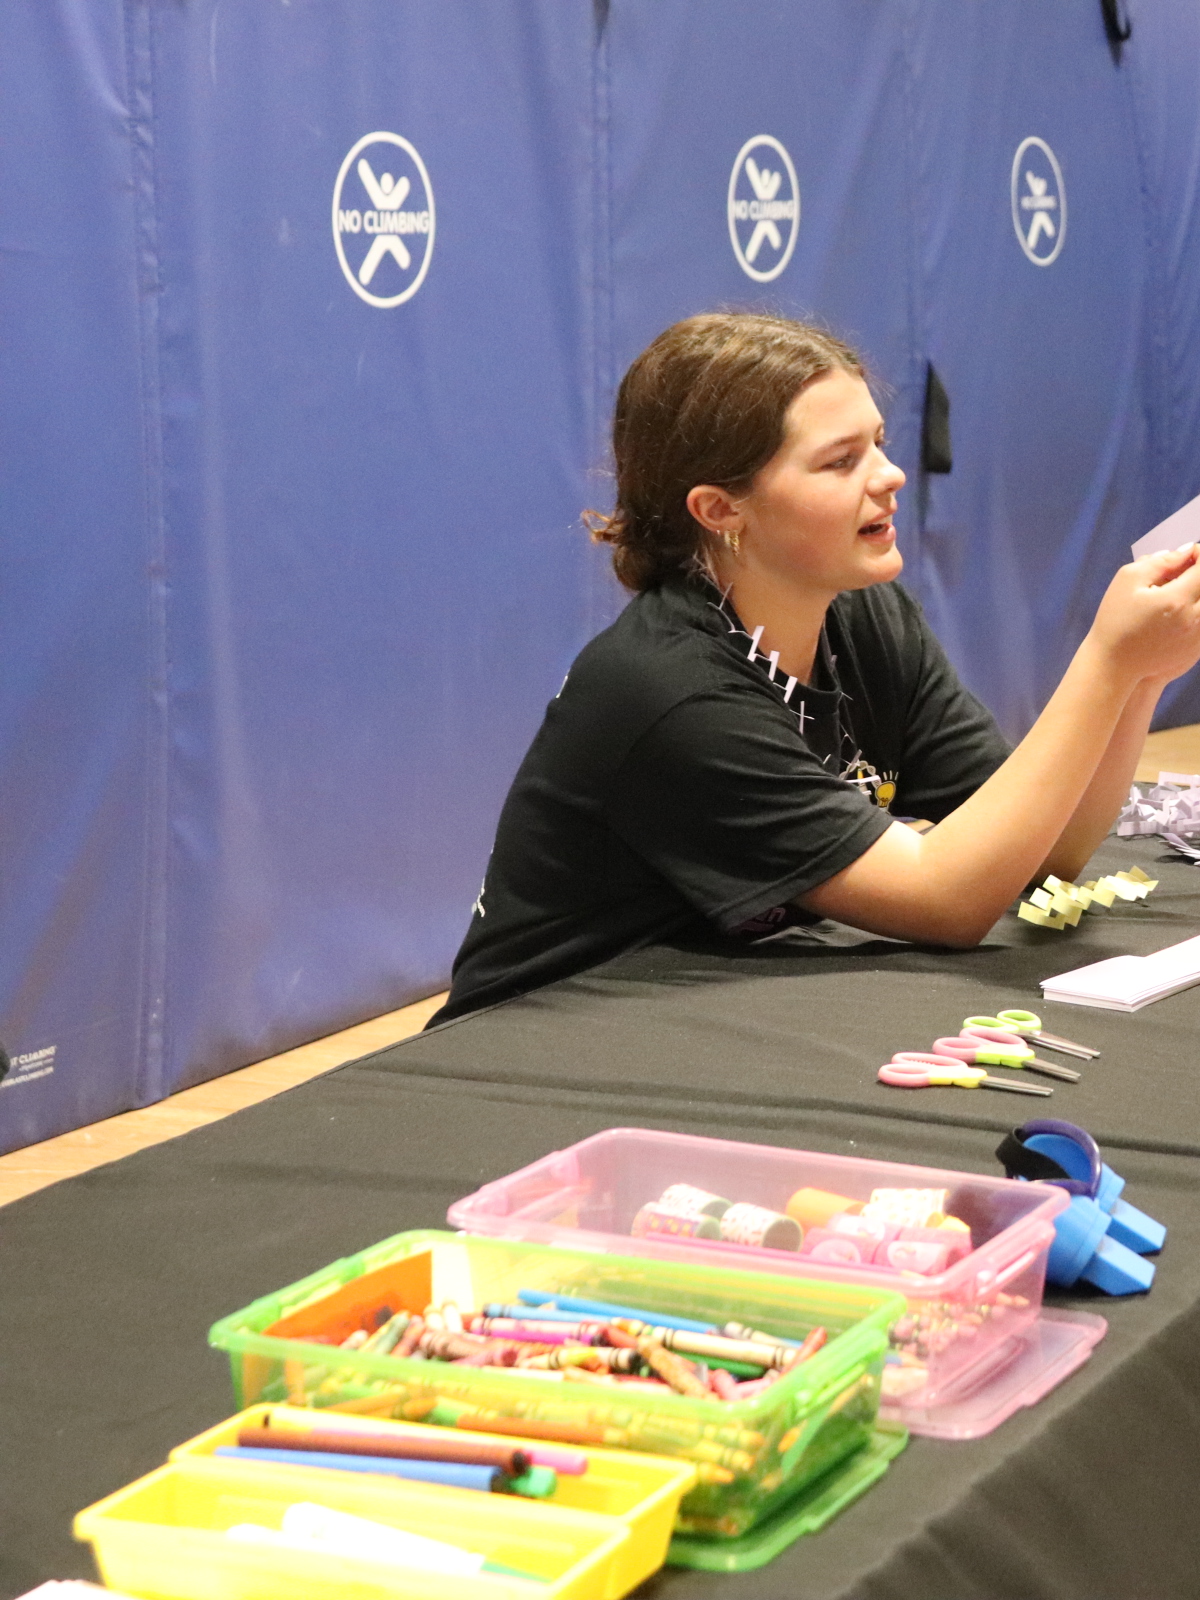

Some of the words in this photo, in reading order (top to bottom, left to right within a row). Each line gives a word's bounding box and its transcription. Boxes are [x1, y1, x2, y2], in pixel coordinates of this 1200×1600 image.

[735, 200, 748, 221] NO
[339, 210, 361, 234] NO
[364, 210, 429, 234] CLIMBING
